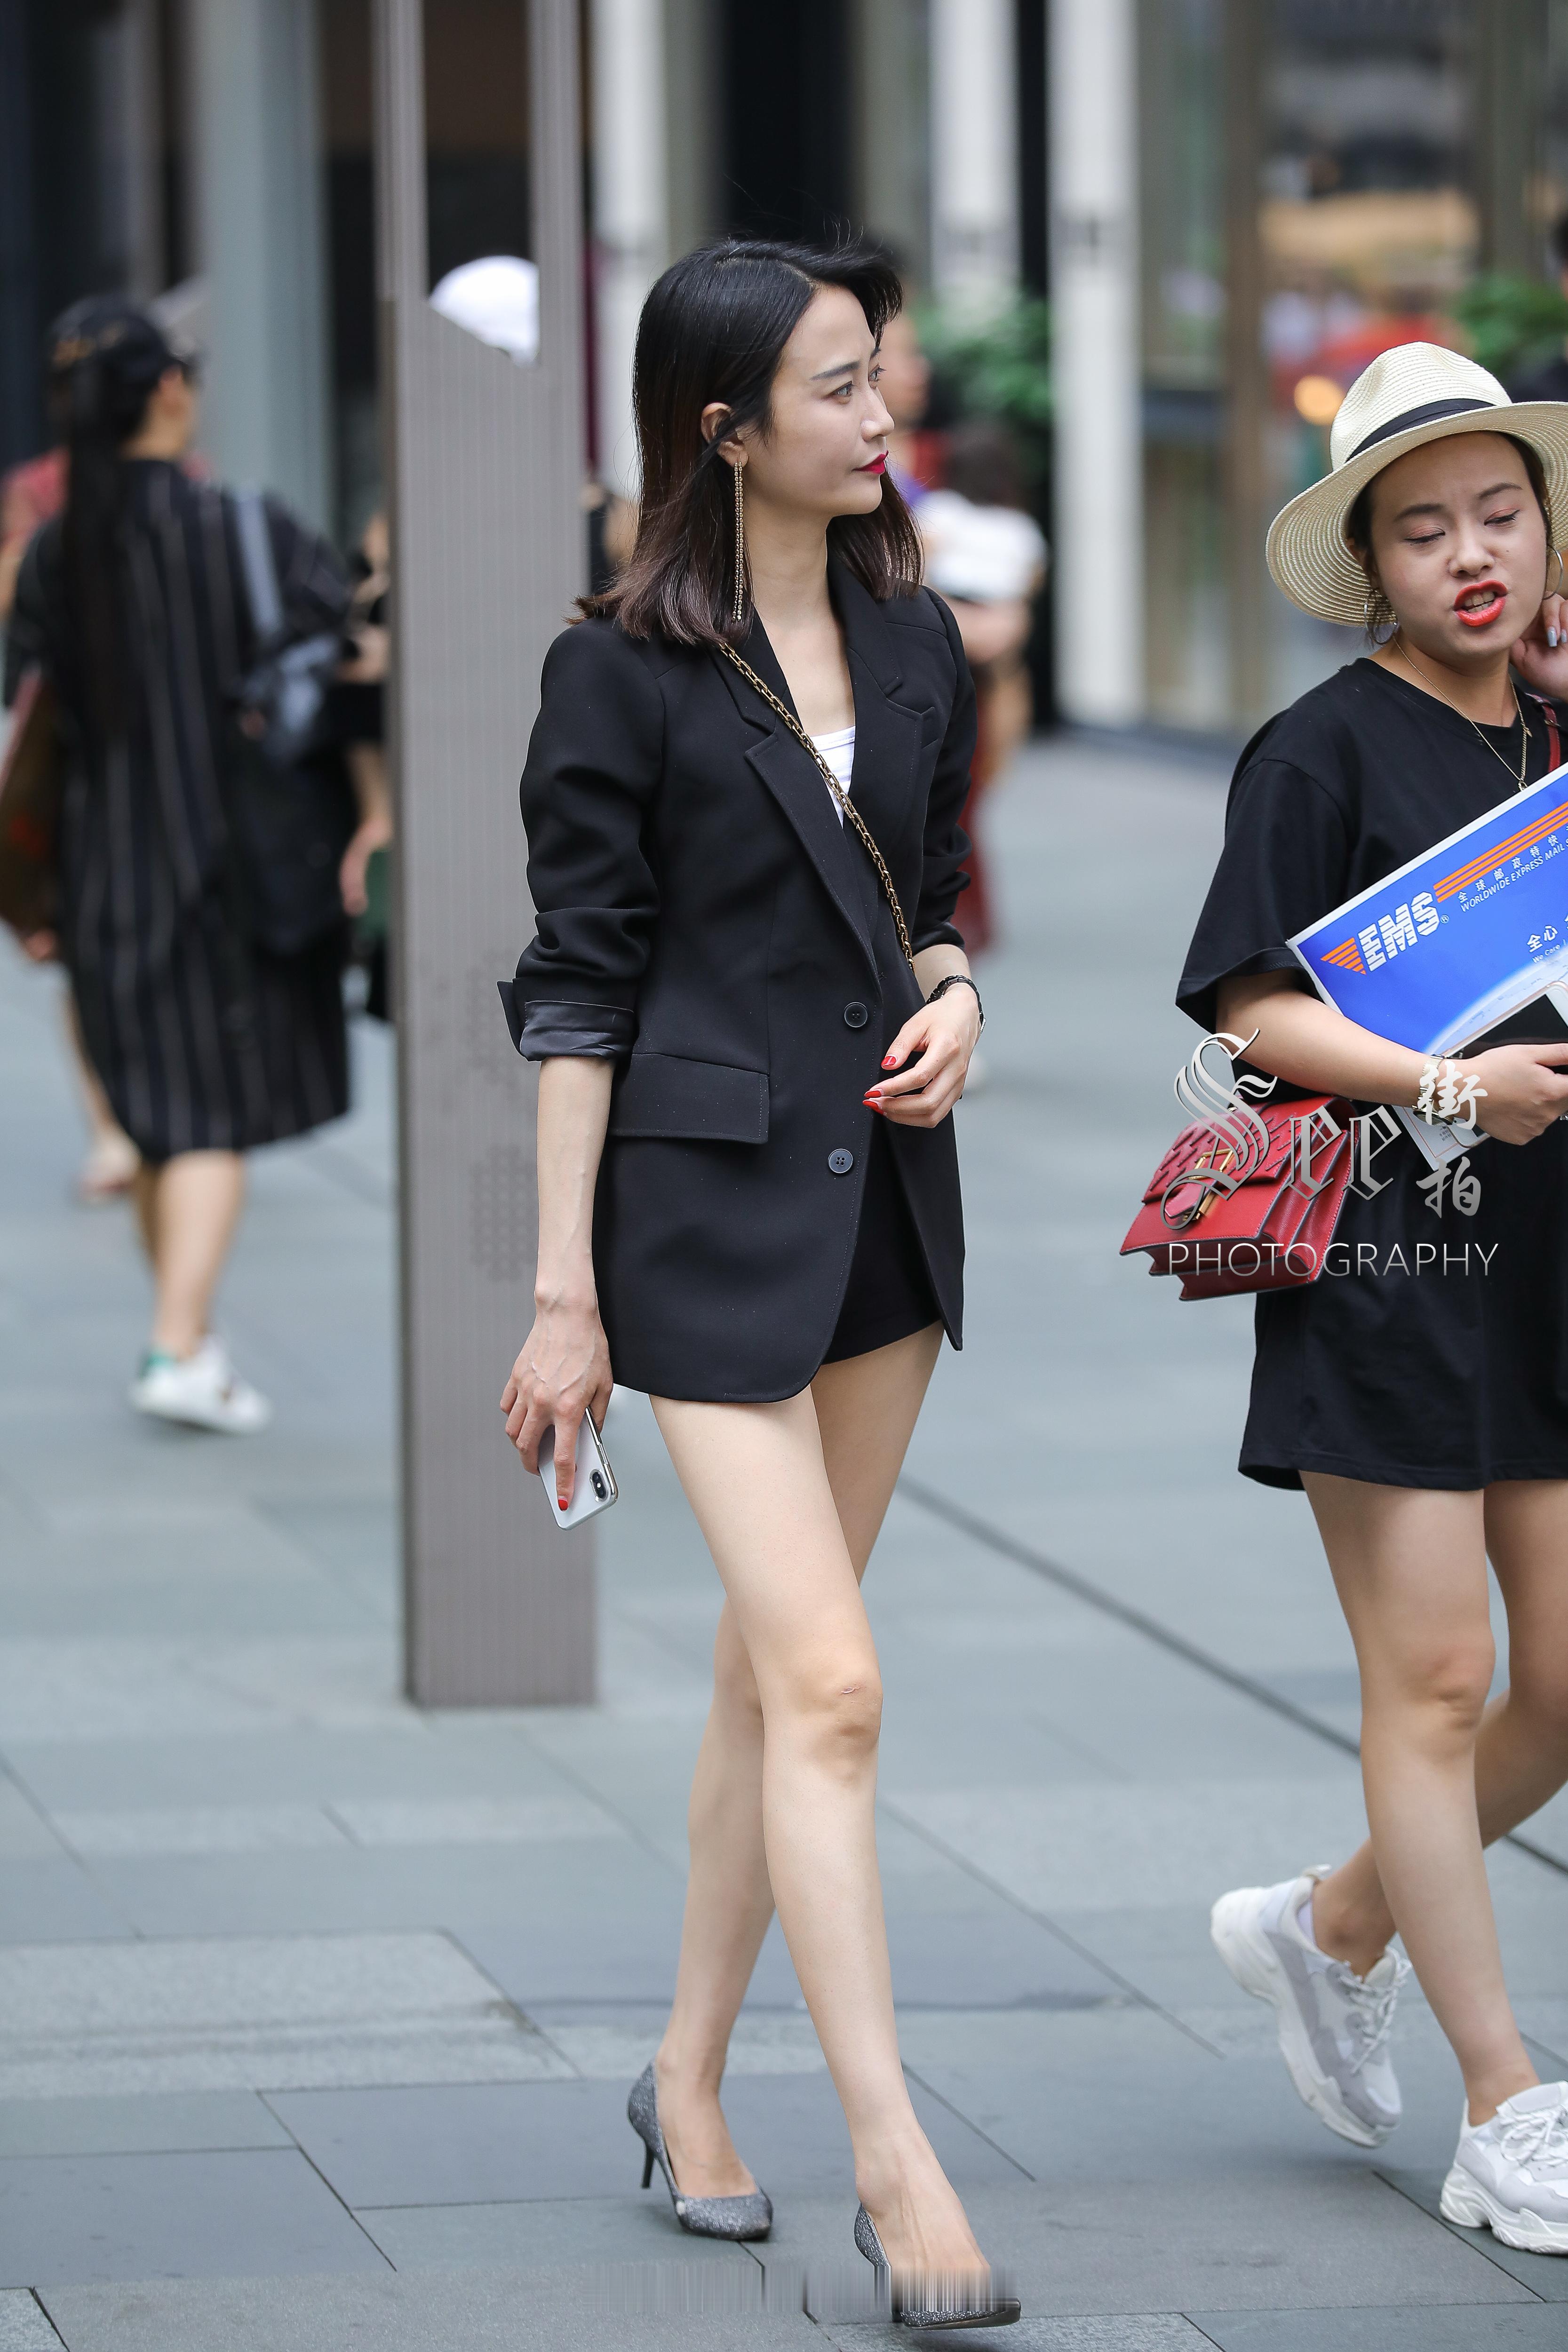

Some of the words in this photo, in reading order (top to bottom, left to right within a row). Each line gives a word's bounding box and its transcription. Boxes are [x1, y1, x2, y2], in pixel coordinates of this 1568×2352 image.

[1457, 824, 1568, 903] 全球邮政特快
[1460, 876, 1510, 912] WORLDWIDE
[1511, 856, 1544, 882] EXPRESS
[1544, 843, 1565, 860] MAIL
[1358, 891, 1440, 972] EMS
